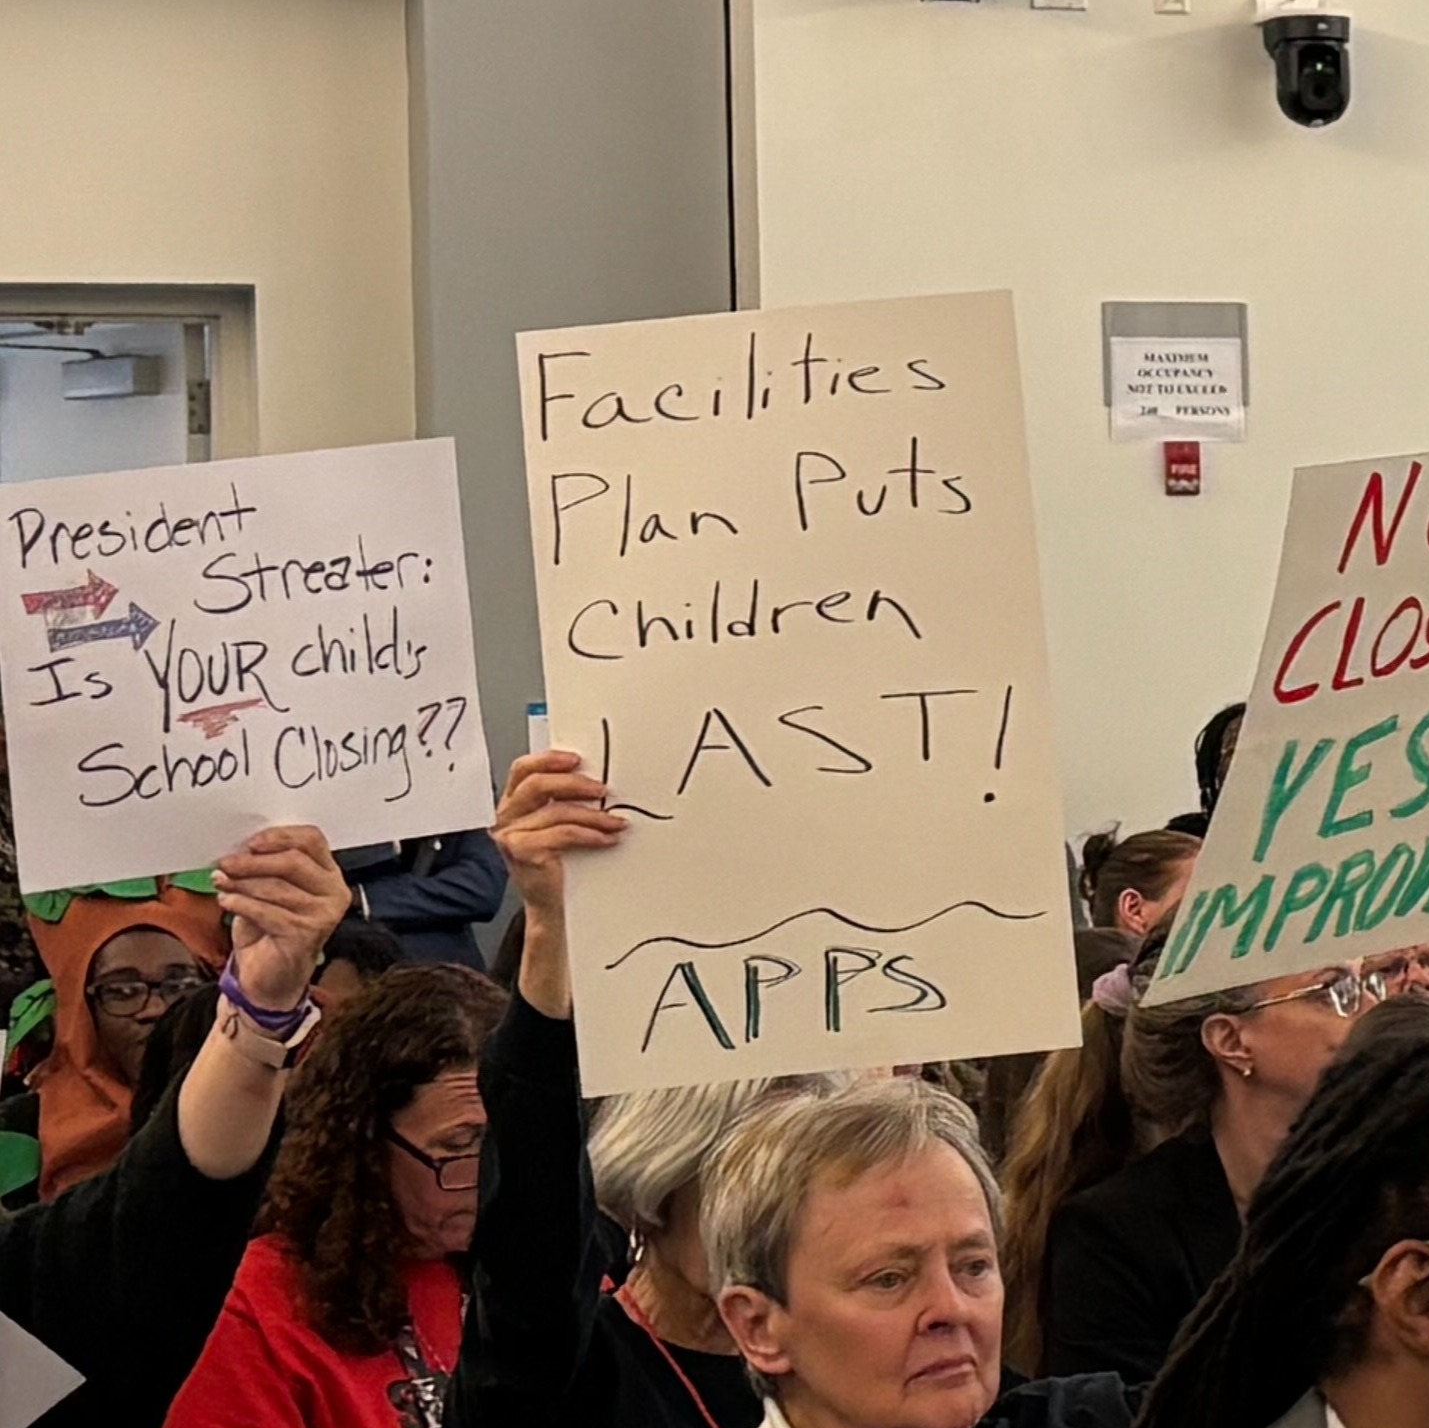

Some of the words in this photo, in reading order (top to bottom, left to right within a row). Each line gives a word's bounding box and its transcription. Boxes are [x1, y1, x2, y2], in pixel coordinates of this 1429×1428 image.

[537, 332, 947, 441] Facilities
[8, 482, 256, 569] President
[550, 473, 739, 565] Plan
[795, 437, 973, 531] Puts
[194, 535, 433, 614] Streater:
[567, 579, 922, 660] Children
[27, 658, 113, 706] Is
[144, 619, 290, 734] YOUR
[79, 729, 249, 806] School
[275, 697, 467, 802] Closing??
[600, 685, 1013, 820] LAST!
[641, 946, 947, 1053] APPS
